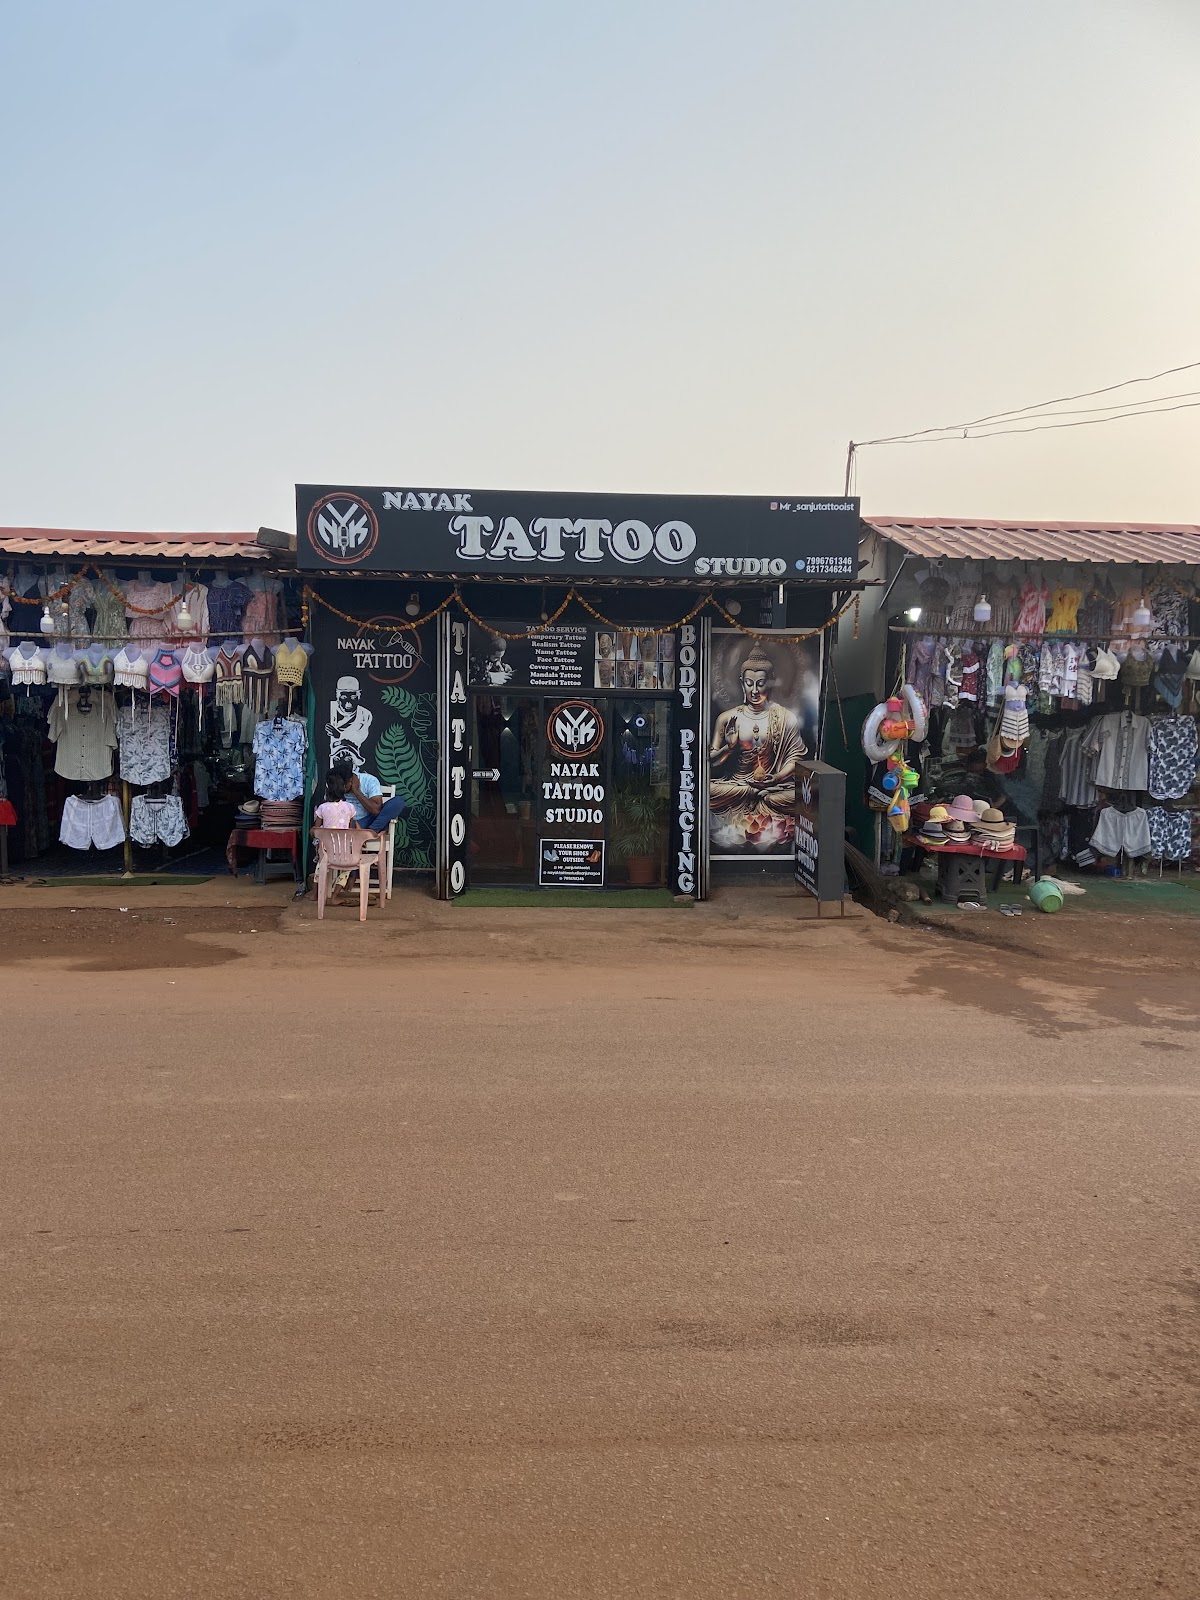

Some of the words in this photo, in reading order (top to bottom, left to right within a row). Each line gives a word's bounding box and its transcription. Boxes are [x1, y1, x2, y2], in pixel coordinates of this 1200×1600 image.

[382, 492, 474, 512] NAYAK
[448, 515, 697, 564] TATTOO
[694, 557, 787, 576] STUDIO
[337, 638, 376, 650] NAYAK
[353, 653, 413, 669] TATTOO
[679, 625, 697, 708] BODY
[550, 763, 600, 777] NAYAK
[542, 782, 605, 802] TATTOO
[545, 808, 604, 823] STUDIO
[678, 729, 696, 893] PIERCING
[795, 826, 818, 859] TATTOO
